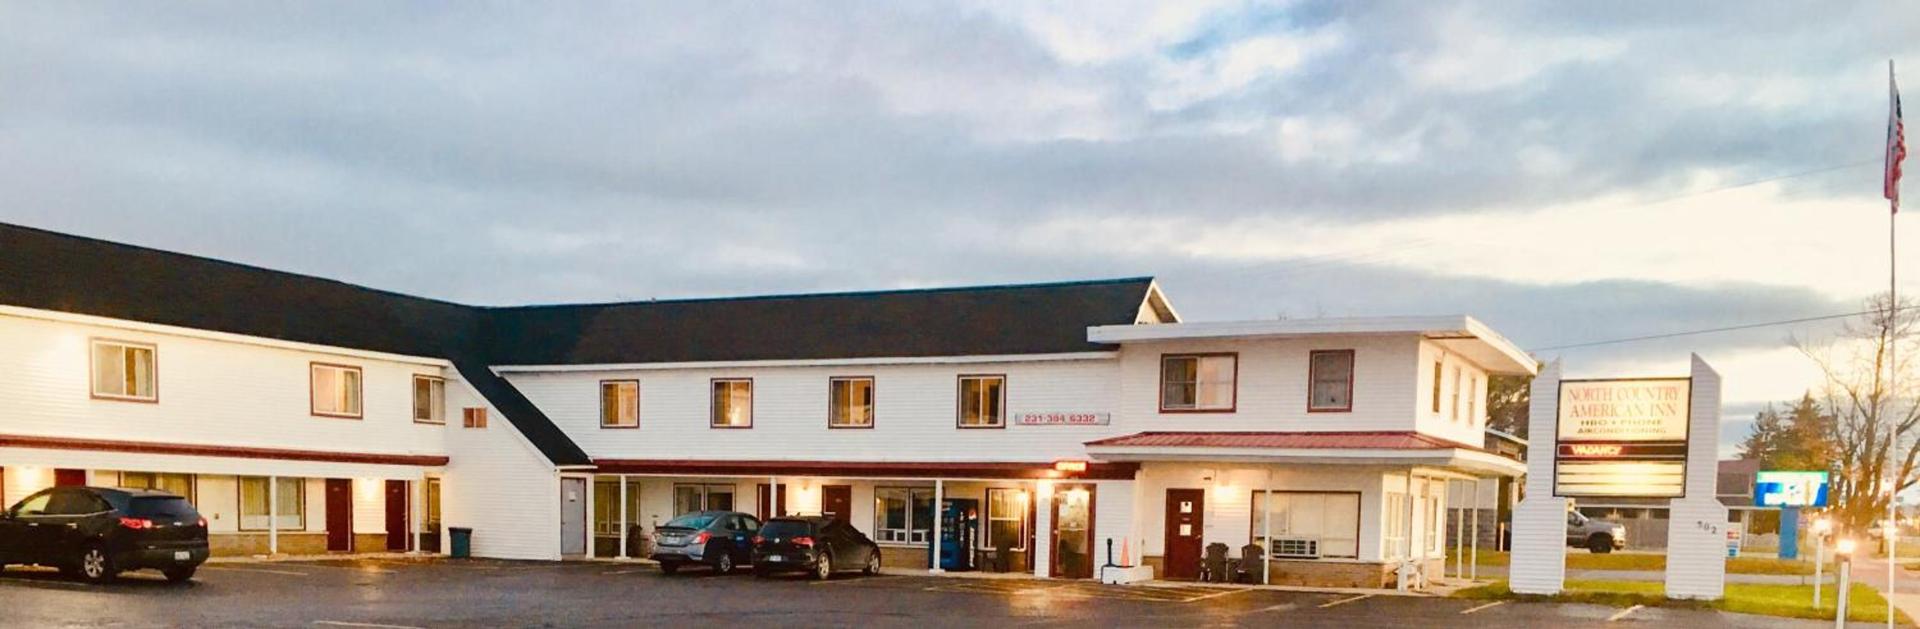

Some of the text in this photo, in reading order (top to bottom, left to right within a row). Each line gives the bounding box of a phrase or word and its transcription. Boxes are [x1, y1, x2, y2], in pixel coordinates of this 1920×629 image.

[1569, 386, 1679, 401] NORTH COUNTRY
[1570, 403, 1678, 417] AMERICAN INN
[1069, 414, 1096, 424] 6332
[1620, 419, 1663, 427] PHONE
[1571, 445, 1622, 456] VACANCY
